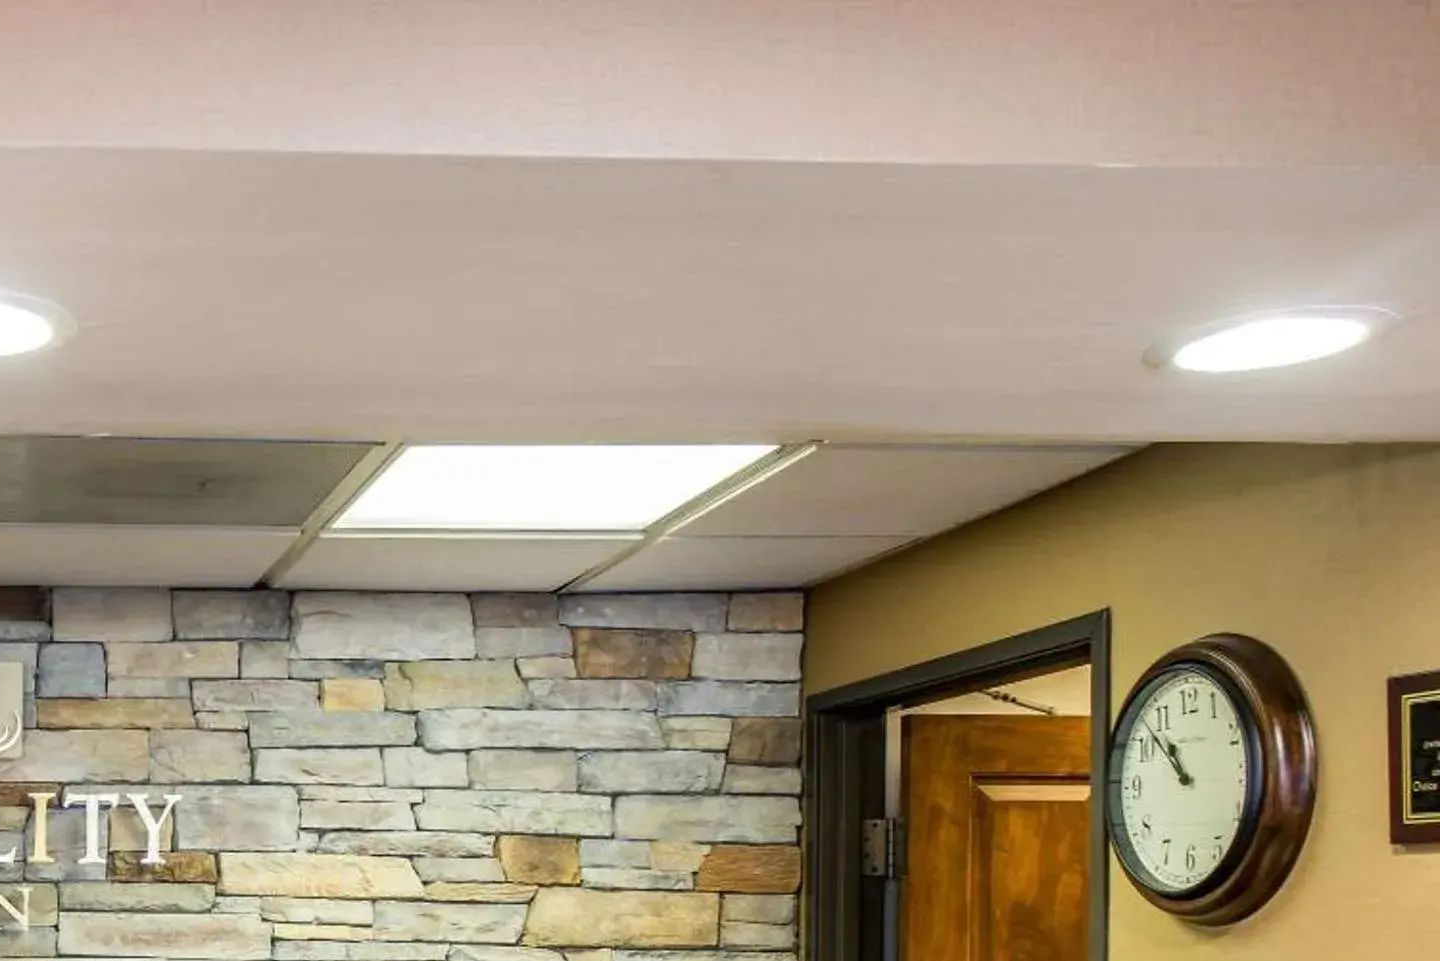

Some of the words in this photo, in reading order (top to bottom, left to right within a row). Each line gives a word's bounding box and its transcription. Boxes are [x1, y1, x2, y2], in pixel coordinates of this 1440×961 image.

[1179, 688, 1198, 715] 12
[1210, 691, 1218, 719] 1
[1155, 704, 1171, 732] 11
[1135, 736, 1157, 763] 10
[1131, 774, 1142, 800] 9
[1162, 838, 1172, 866] 7
[1185, 844, 1196, 872] 6
